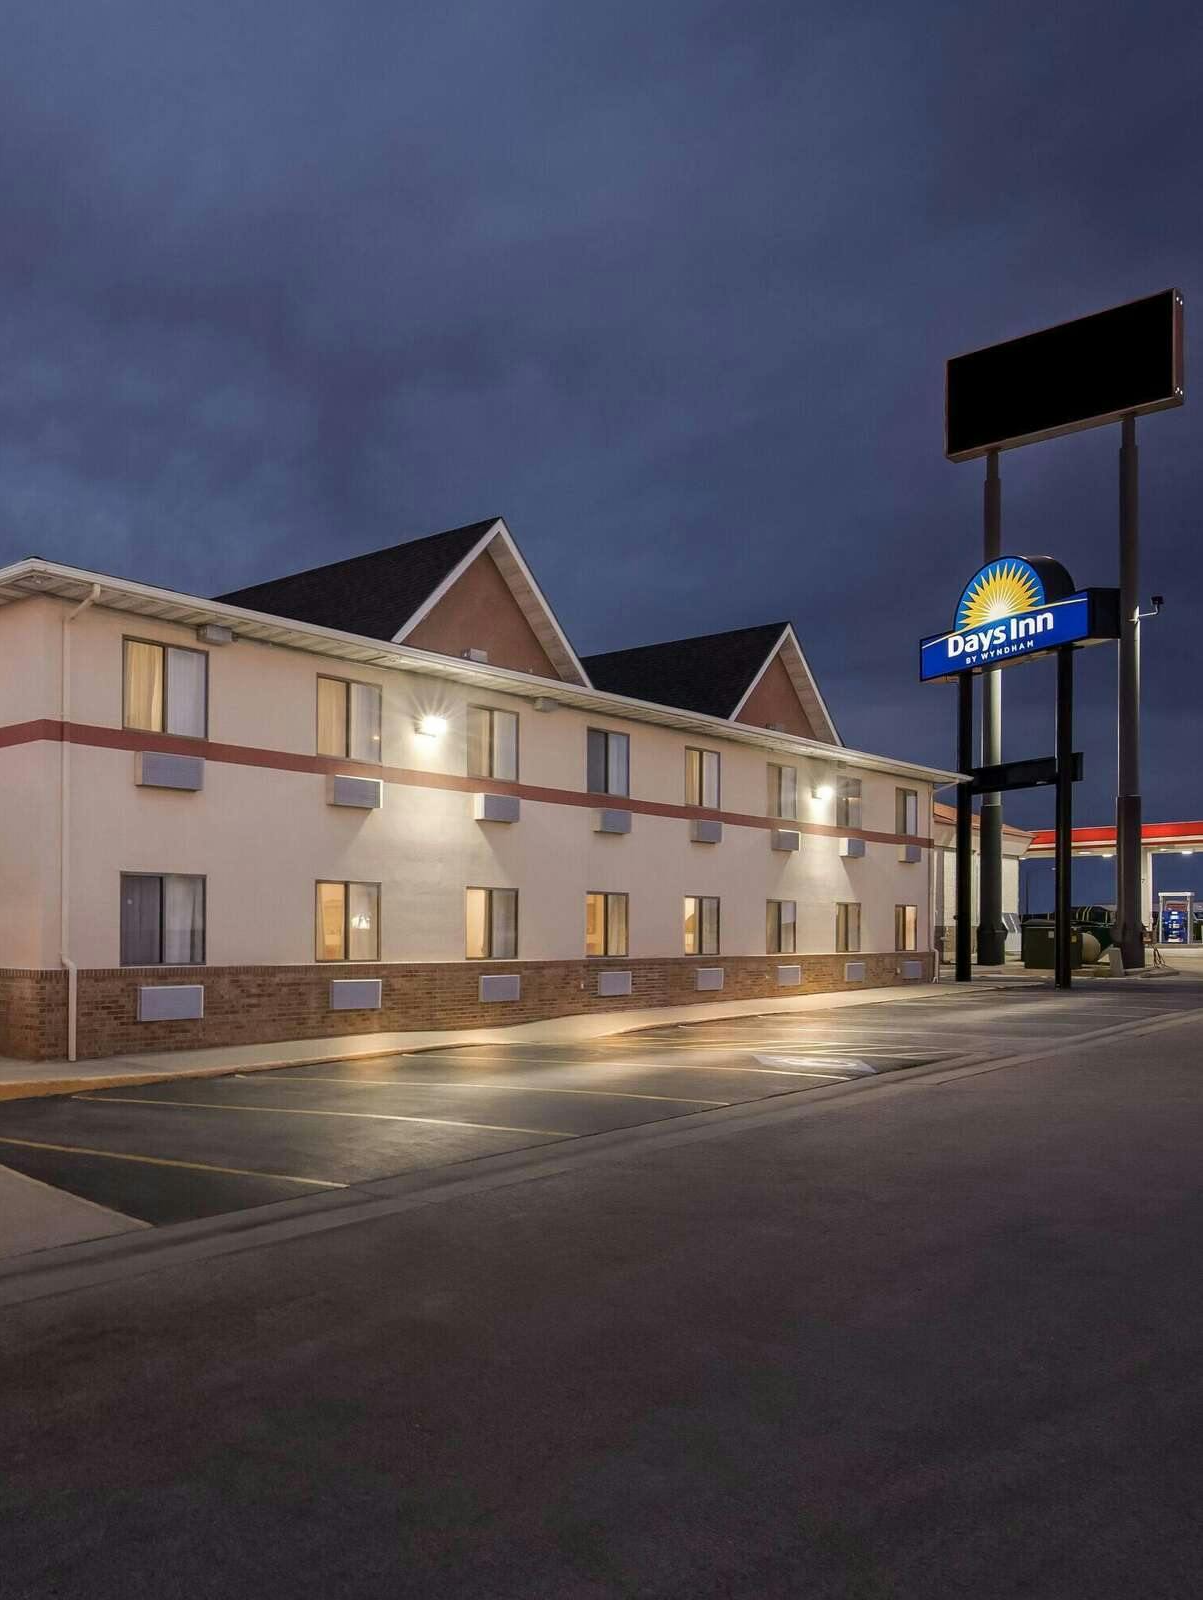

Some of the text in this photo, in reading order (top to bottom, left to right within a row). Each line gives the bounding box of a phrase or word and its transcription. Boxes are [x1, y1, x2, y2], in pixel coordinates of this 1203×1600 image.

[947, 612, 1054, 658] Days Inn
[965, 640, 1034, 664] BY WYNDHAM
